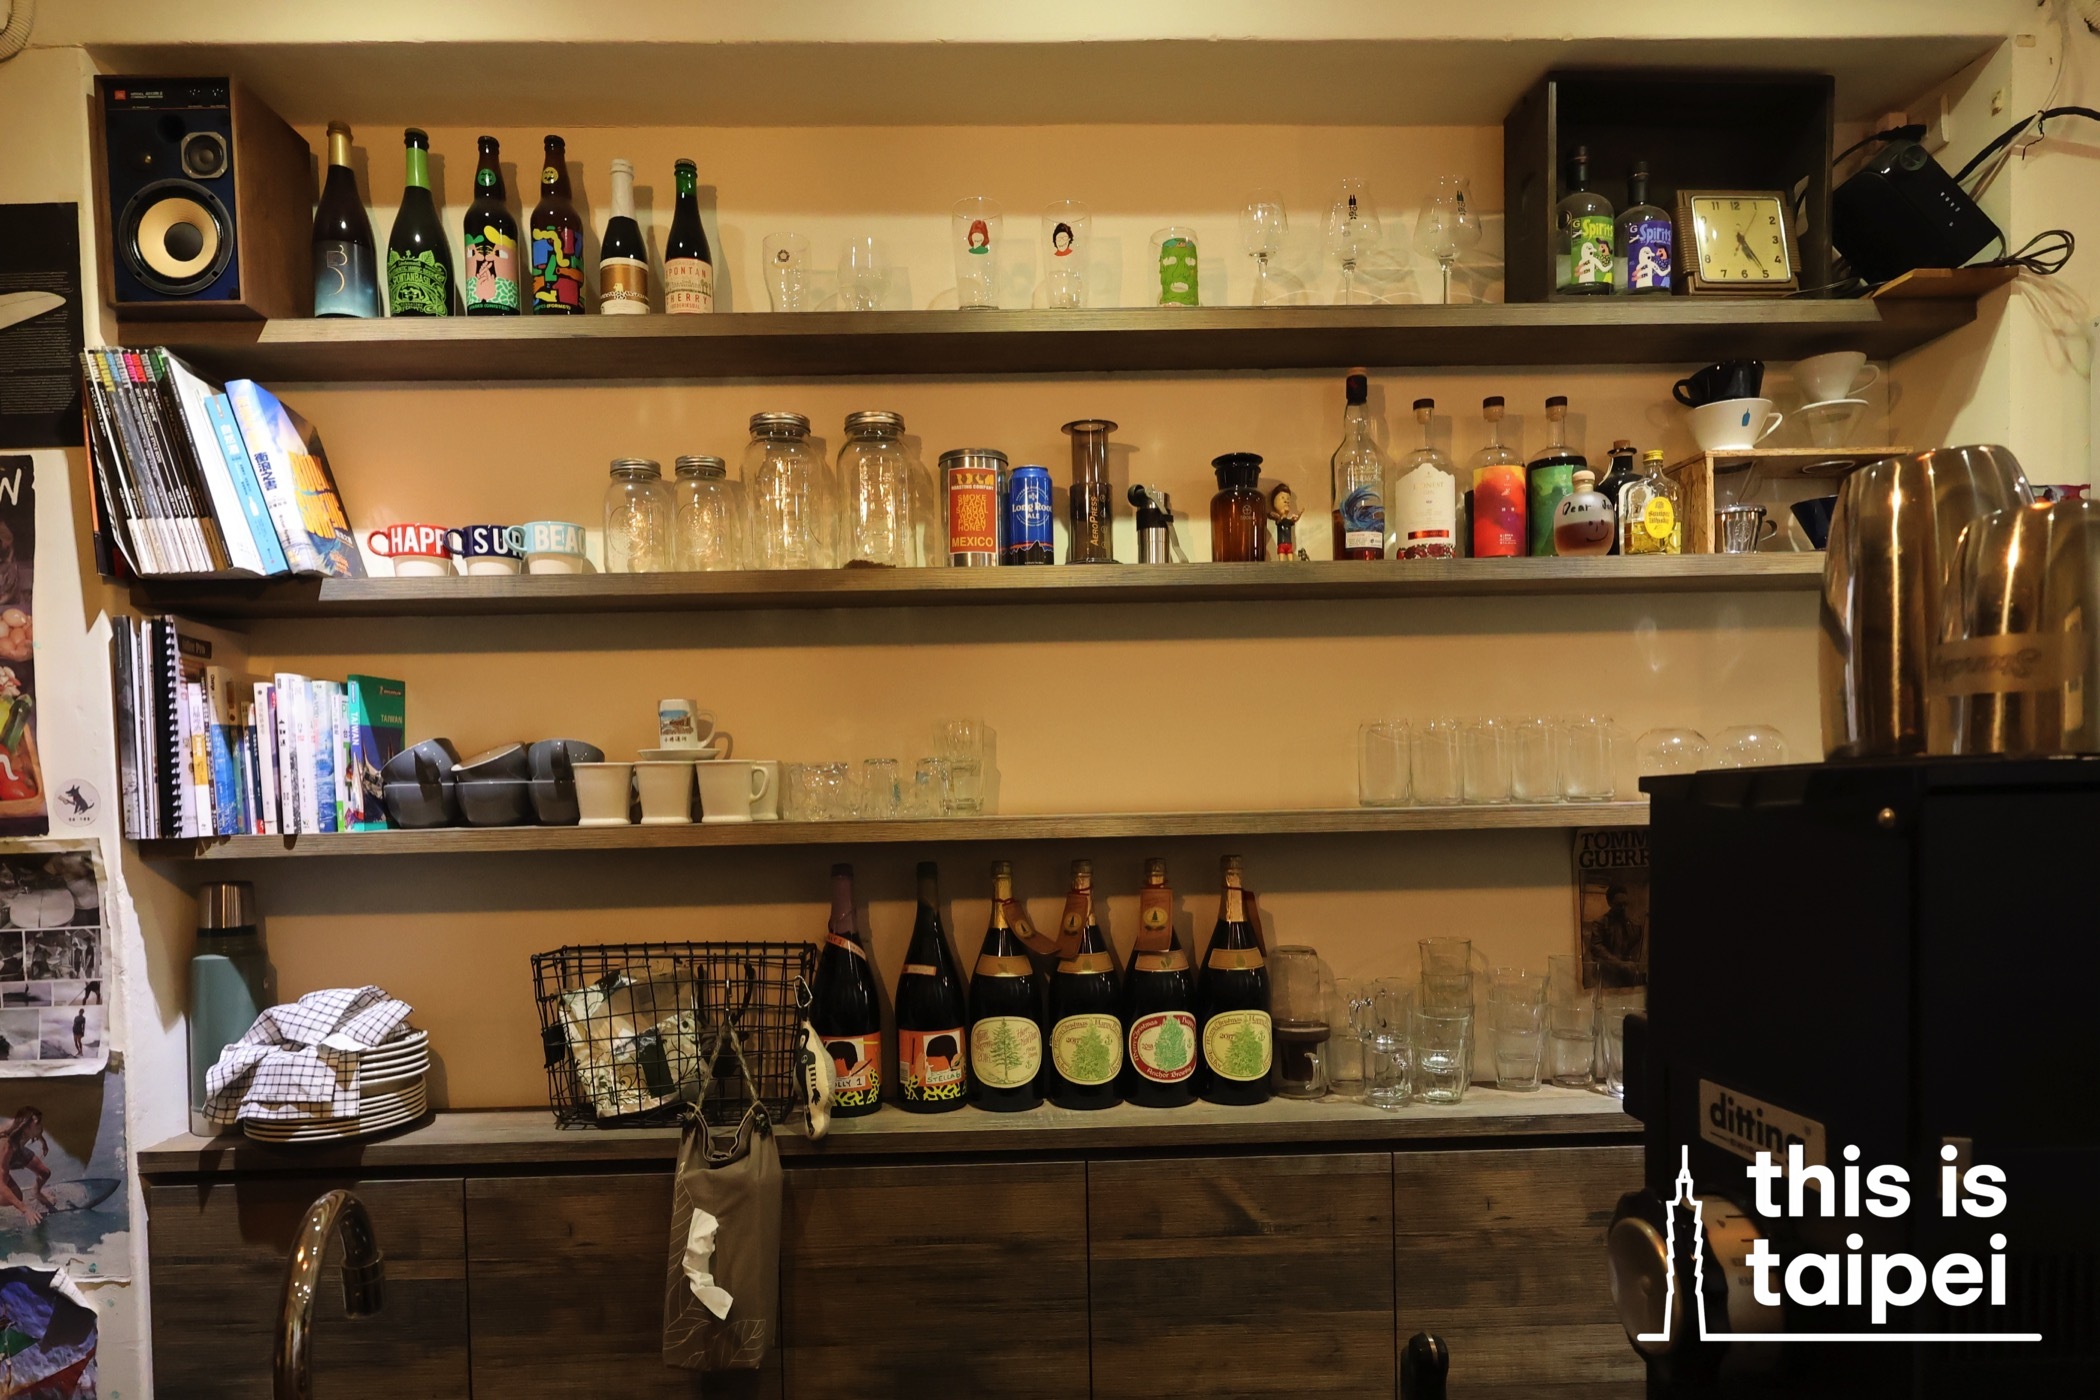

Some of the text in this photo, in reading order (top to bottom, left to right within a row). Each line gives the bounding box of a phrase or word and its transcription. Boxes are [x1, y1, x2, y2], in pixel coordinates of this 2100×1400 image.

[1711, 202, 1720, 210] 11
[1730, 202, 1740, 210] 12
[1753, 202, 1758, 210] 1
[1769, 216, 1776, 225] 2
[1583, 219, 1614, 240] Spirits
[1640, 223, 1671, 245] Spirits
[1772, 236, 1779, 244] 3
[1705, 255, 1711, 263] 8
[1775, 256, 1782, 264] 4
[1720, 269, 1727, 278] 7
[1741, 270, 1748, 278] 6
[1762, 270, 1769, 278] 5
[956, 506, 989, 514] SANDAL
[1012, 503, 1034, 513] Long
[1563, 501, 1591, 515] Dear
[951, 537, 994, 547] MEXICO
[381, 714, 403, 724] TAIWAN
[351, 711, 360, 746] TAIWAN
[1133, 1020, 1158, 1039] Christmas
[1146, 1068, 1169, 1079] Anchor
[857, 1078, 863, 1086] 1
